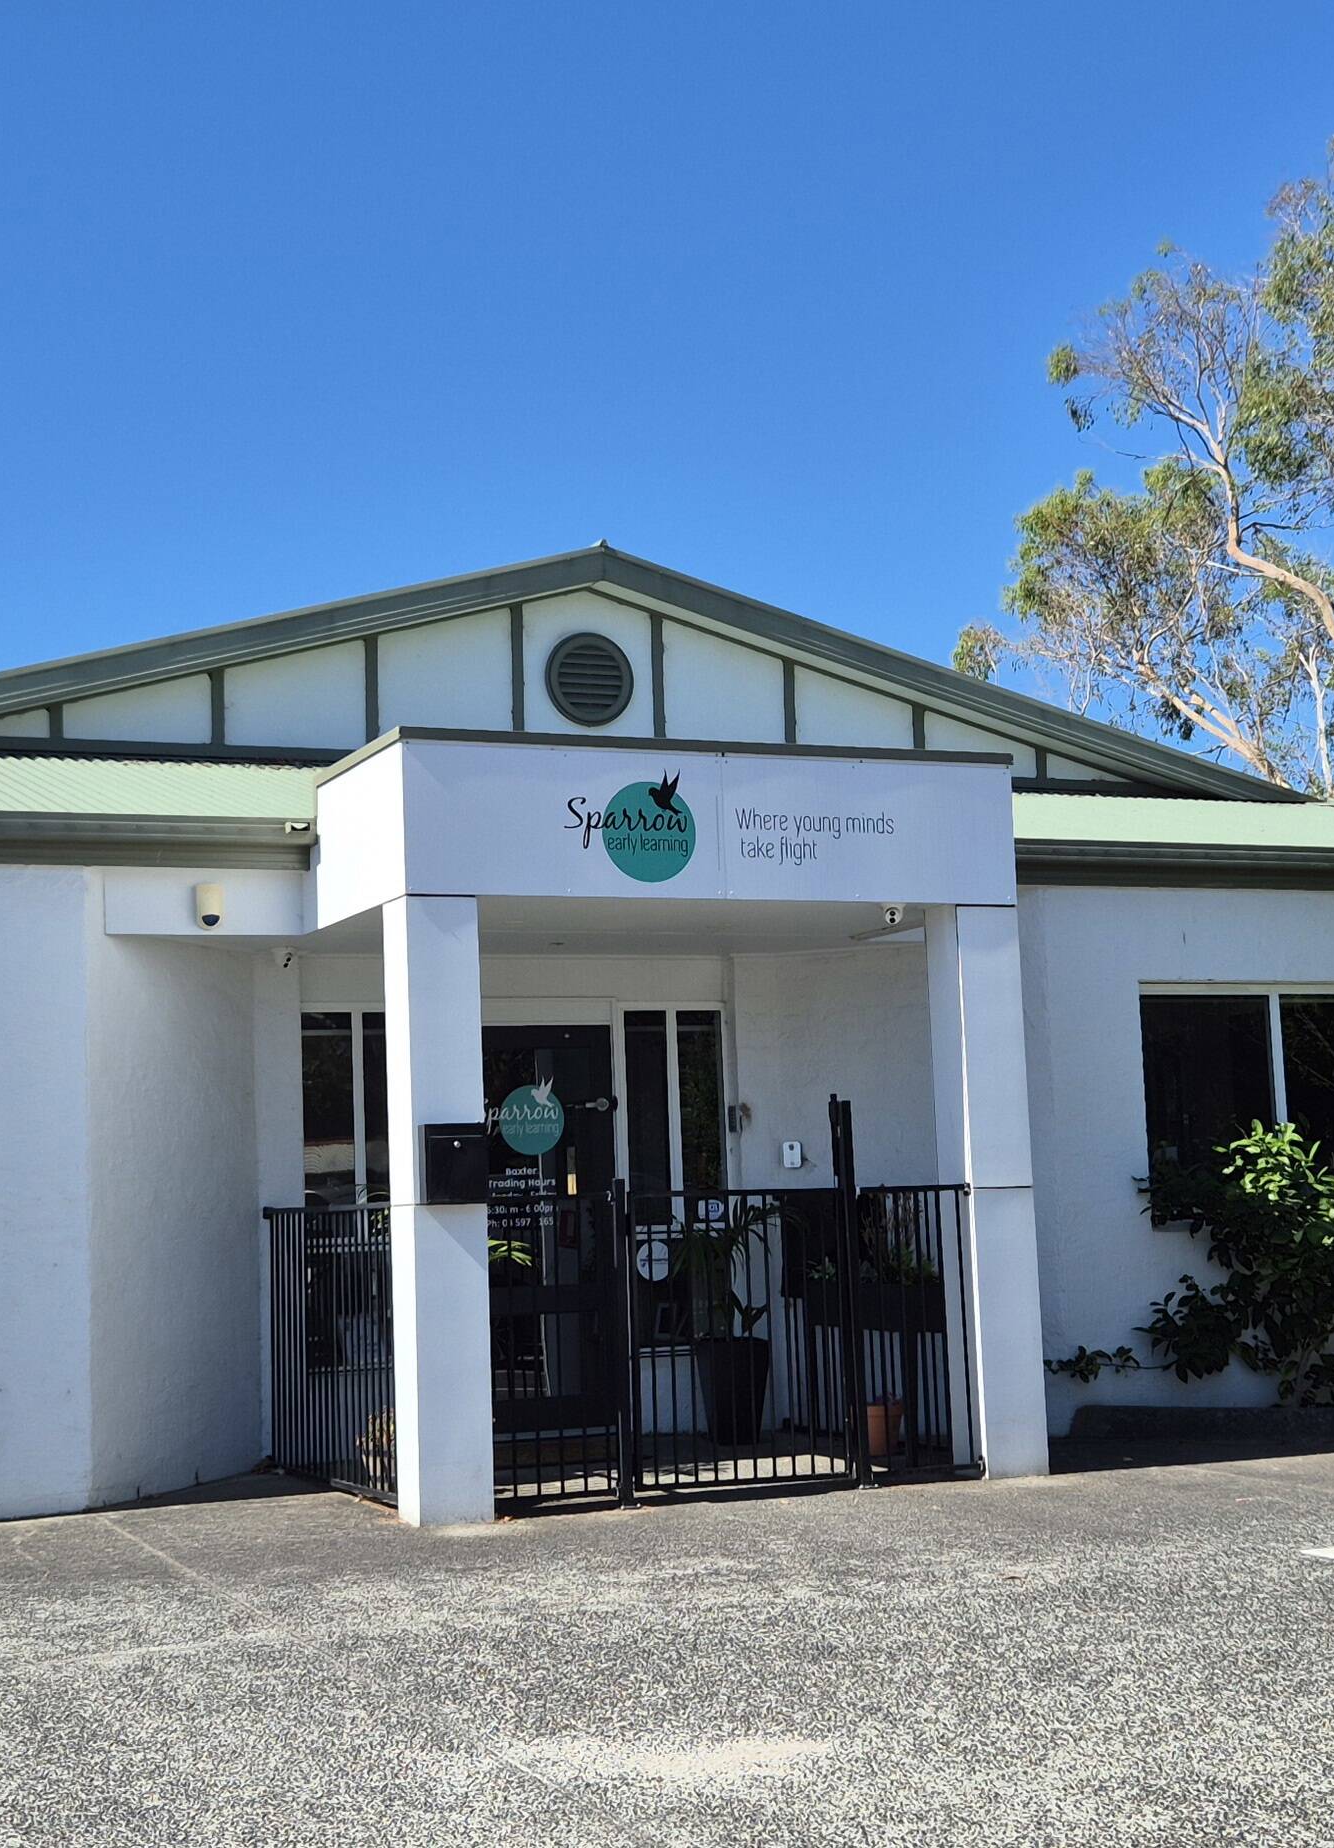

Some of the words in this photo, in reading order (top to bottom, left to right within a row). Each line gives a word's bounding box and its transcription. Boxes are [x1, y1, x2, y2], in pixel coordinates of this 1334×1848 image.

[563, 796, 688, 849] Sparrow
[735, 807, 788, 832] Where
[793, 814, 841, 840] young
[845, 812, 895, 834] minds
[607, 833, 637, 857] early
[640, 833, 688, 858] learning
[740, 836, 775, 859] take
[778, 836, 817, 866] flight
[484, 1097, 559, 1136] parrow
[488, 1179, 526, 1189] Trading
[528, 1178, 556, 1187] Hours
[505, 1166, 538, 1176] Baxter
